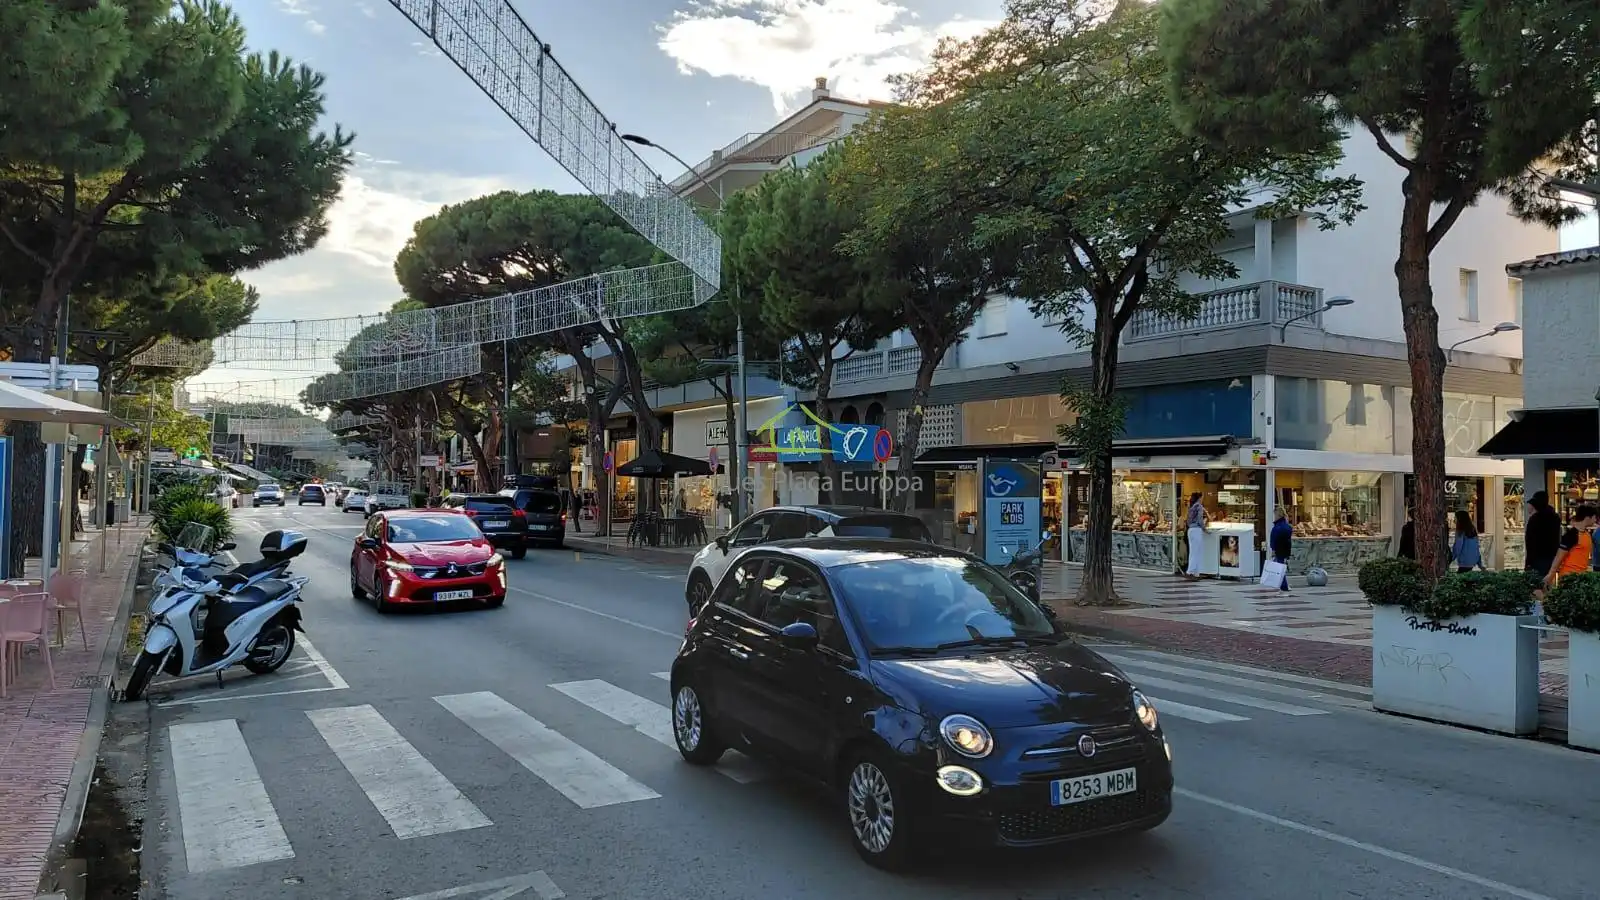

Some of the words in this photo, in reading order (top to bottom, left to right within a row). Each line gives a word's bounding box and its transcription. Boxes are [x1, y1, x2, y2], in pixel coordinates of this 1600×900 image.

[1001, 503, 1023, 513] PARK
[1063, 778, 1102, 800] 8253
[1107, 771, 1134, 793] MBM
